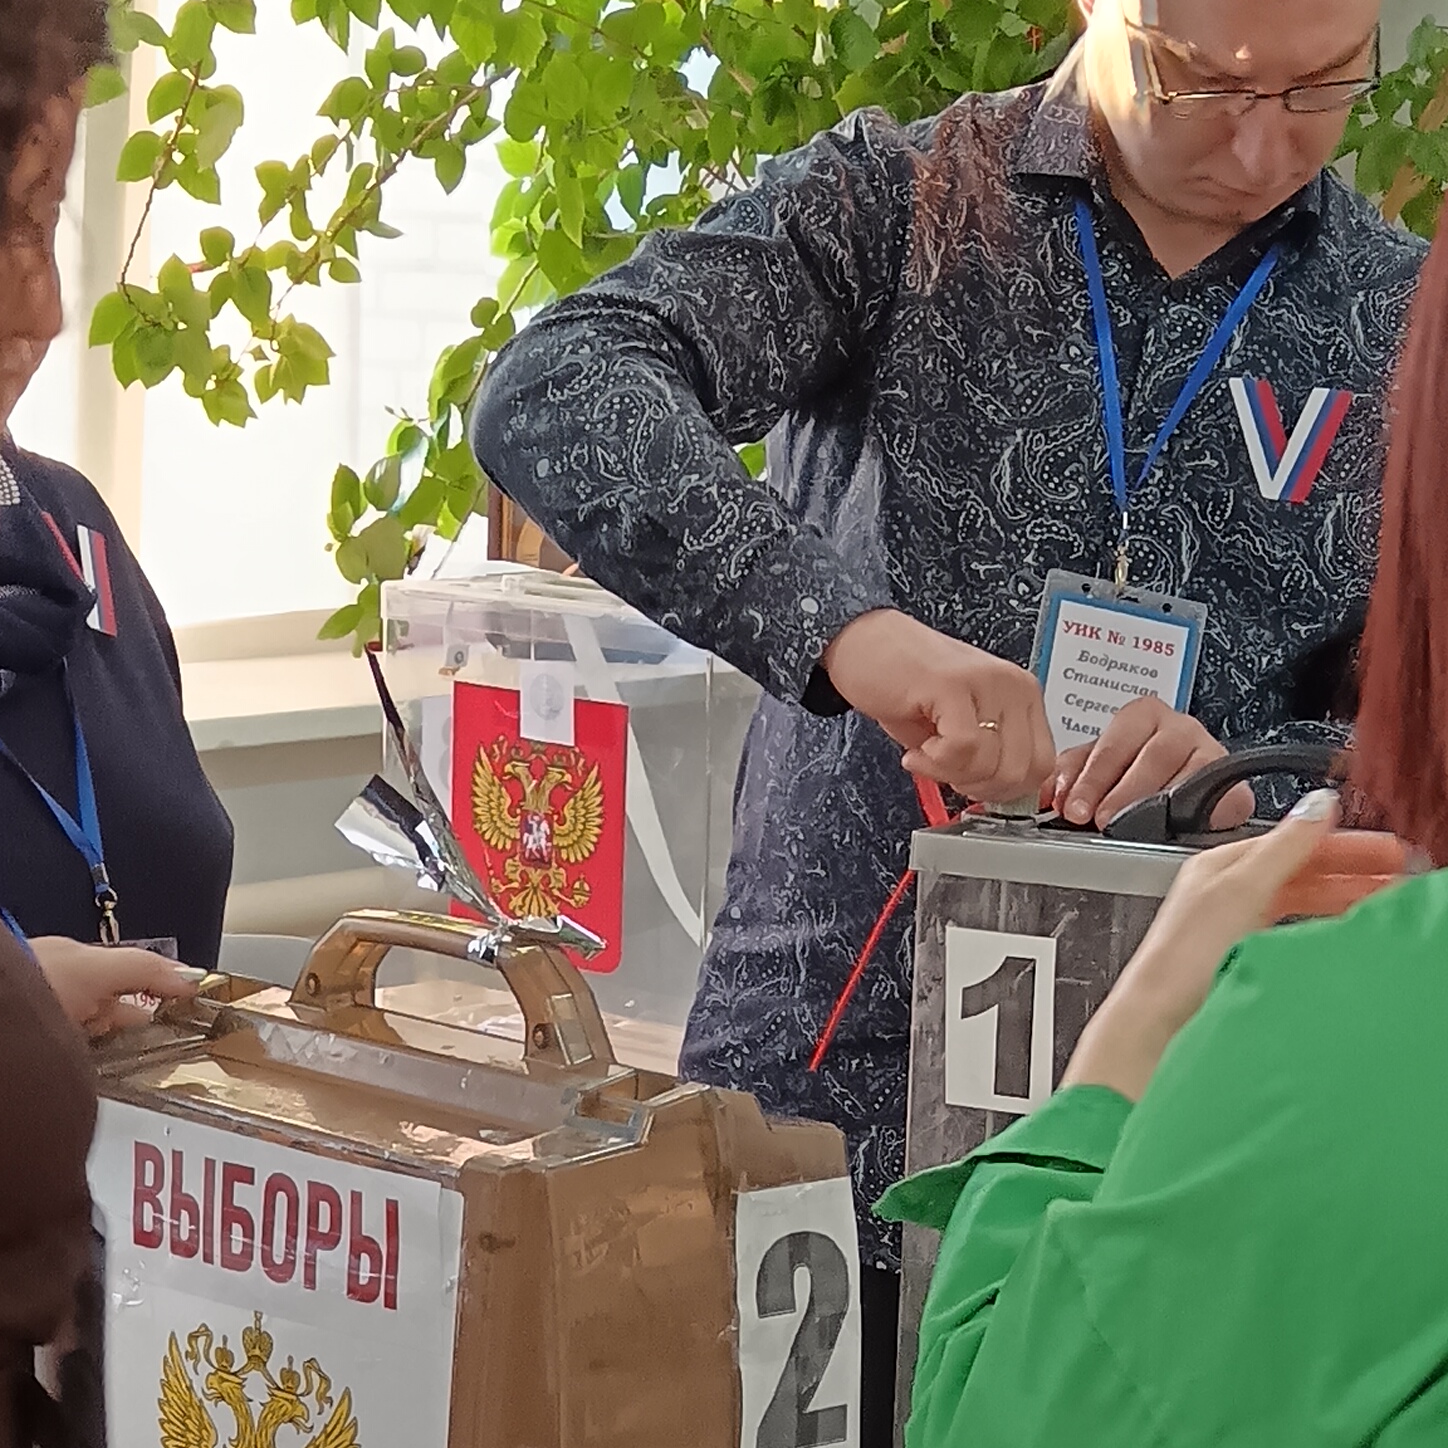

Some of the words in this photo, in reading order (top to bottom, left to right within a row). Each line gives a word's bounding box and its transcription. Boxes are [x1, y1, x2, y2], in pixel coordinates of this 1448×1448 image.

[1061, 619, 1103, 640] УИК
[1107, 629, 1126, 646] №
[1132, 635, 1176, 657] 1985
[1061, 715, 1102, 736] Член
[961, 956, 1036, 1099] 1
[133, 1140, 399, 1310] ВЫБОРЫ
